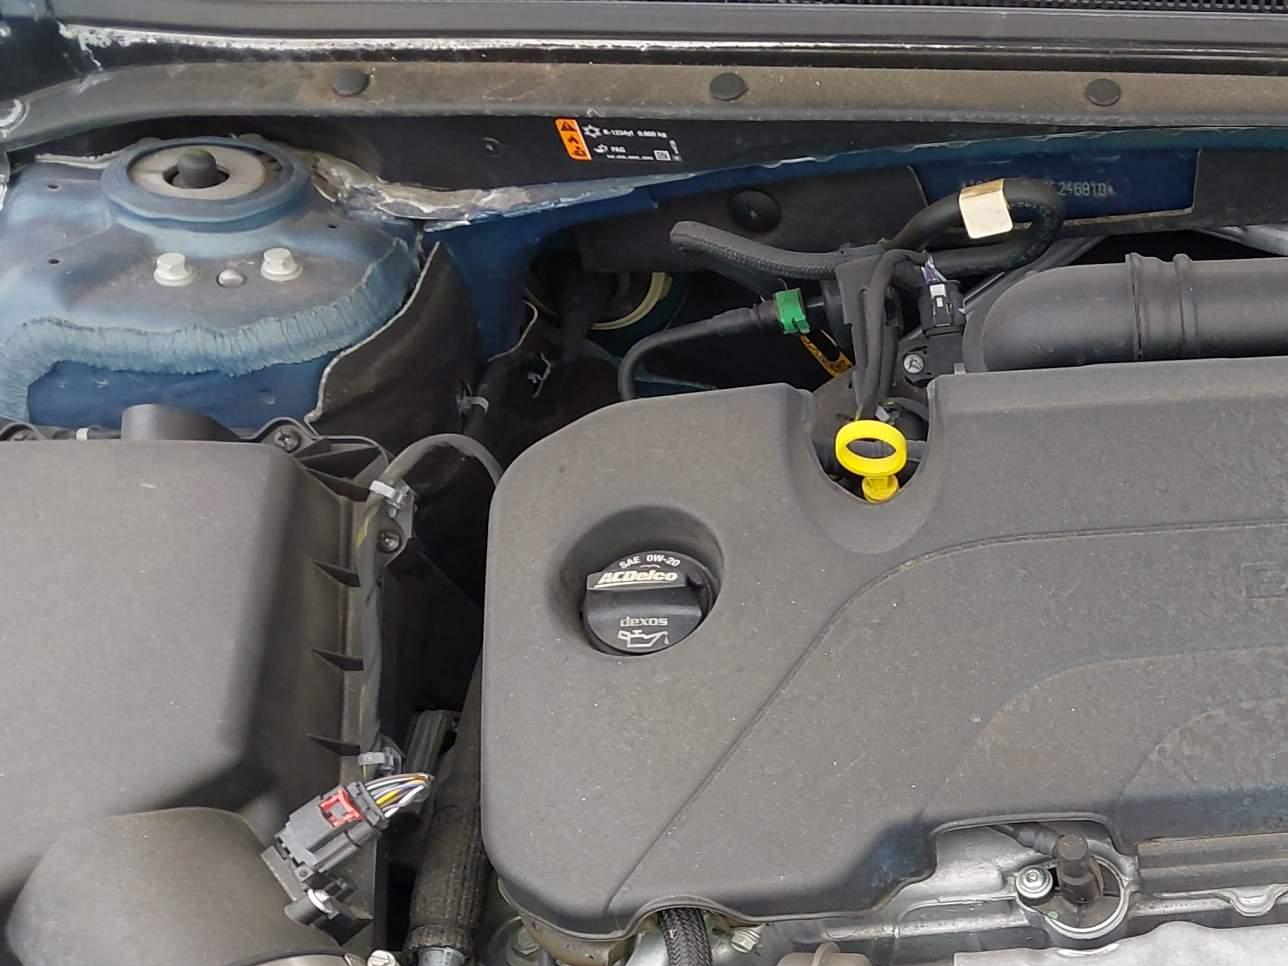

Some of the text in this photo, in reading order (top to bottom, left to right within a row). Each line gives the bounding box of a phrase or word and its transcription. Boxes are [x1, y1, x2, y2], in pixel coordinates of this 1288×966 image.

[619, 554, 681, 569] SAE 0W-20
[597, 569, 678, 585] ACDelco
[620, 616, 669, 628] dexos
